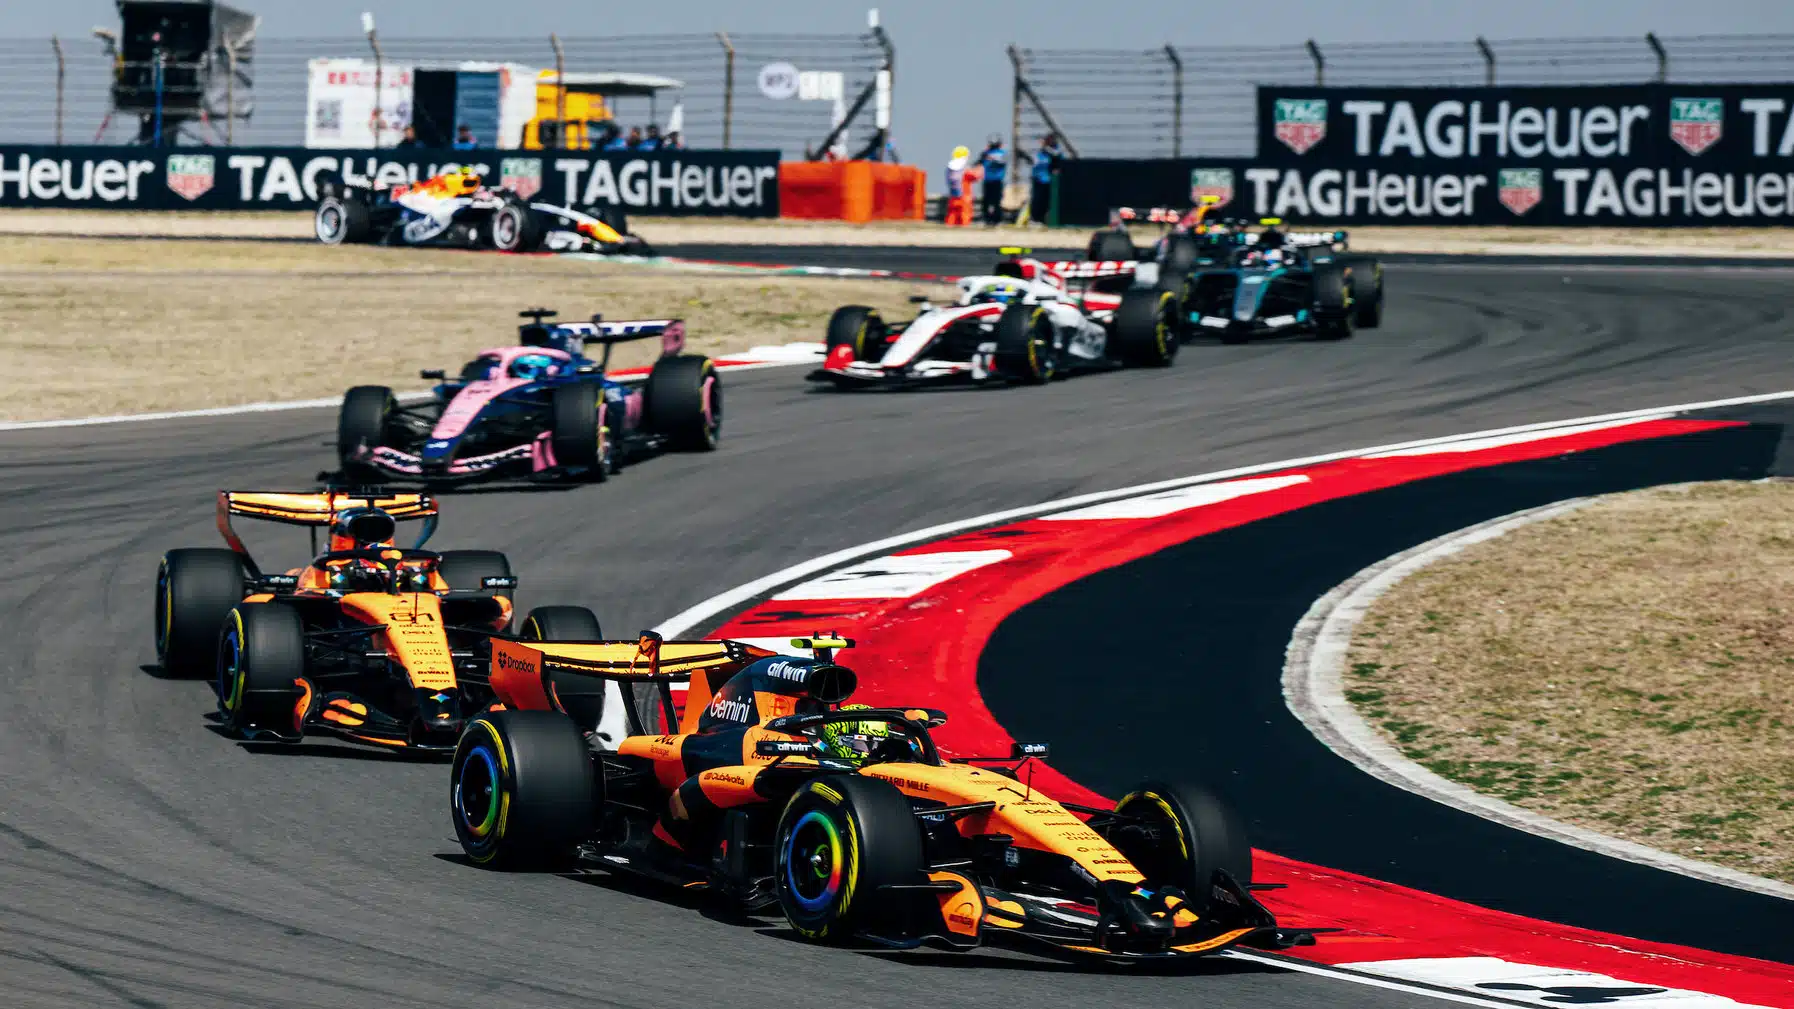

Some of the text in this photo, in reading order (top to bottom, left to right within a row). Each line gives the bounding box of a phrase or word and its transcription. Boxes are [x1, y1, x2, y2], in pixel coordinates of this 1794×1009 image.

[508, 657, 535, 674] Dropbox
[710, 691, 752, 723] Gemini
[906, 779, 930, 792] MILLE
